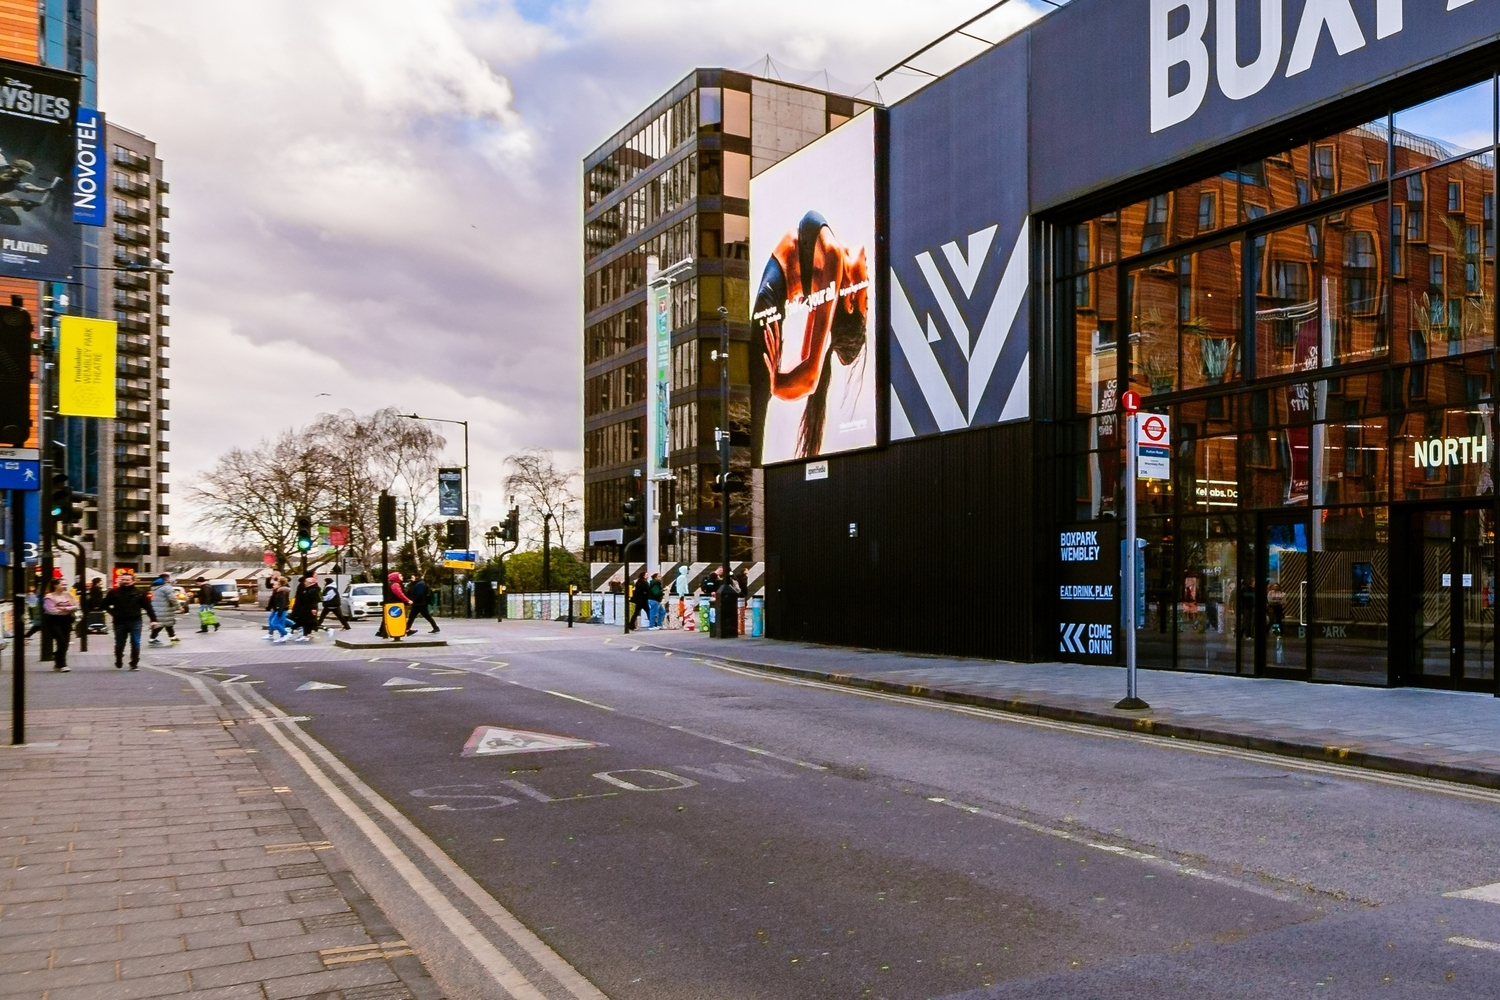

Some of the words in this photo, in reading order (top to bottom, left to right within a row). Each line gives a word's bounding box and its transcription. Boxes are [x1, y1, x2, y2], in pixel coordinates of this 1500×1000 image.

[74, 117, 97, 210] NOVOTEL
[3, 238, 49, 255] PLAYING
[84, 328, 93, 347] PARK
[83, 348, 92, 384] WEMBLEY
[93, 353, 102, 384] THEATRE
[1128, 393, 1137, 409] L
[1414, 435, 1487, 468] NORTH
[1060, 531, 1097, 546] BOXPARK
[1060, 546, 1100, 561] WEMBLEY
[1088, 624, 1112, 639] COME
[1088, 639, 1100, 654] ON
[1101, 640, 1113, 655] IN!
[409, 762, 797, 812] SLOW
